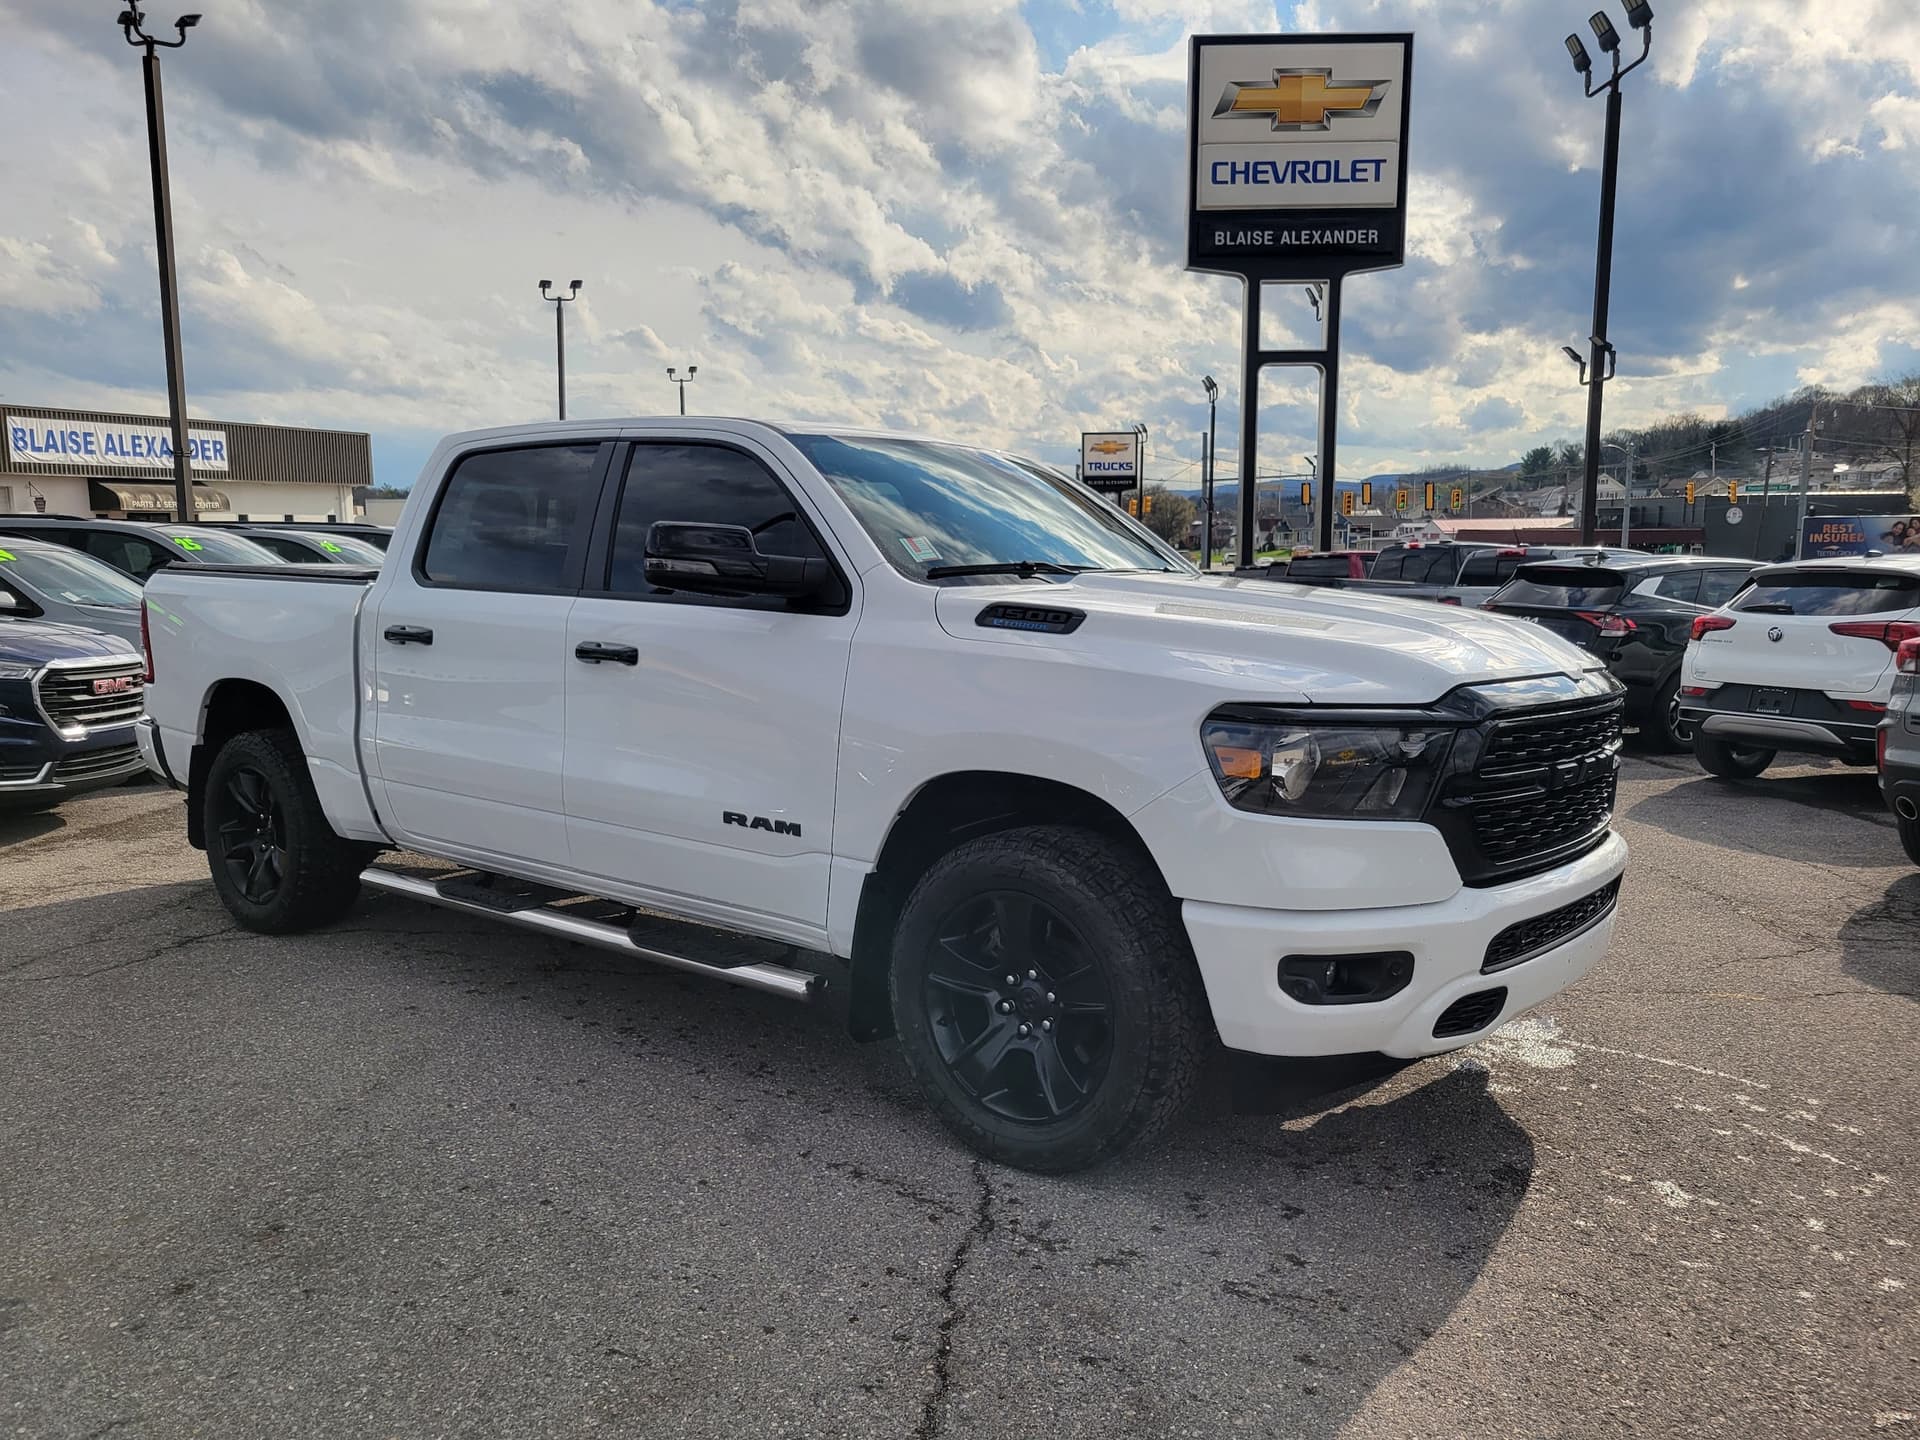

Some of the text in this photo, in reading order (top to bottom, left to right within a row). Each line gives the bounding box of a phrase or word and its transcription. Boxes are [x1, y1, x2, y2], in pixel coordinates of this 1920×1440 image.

[1211, 159, 1387, 185] CHEVROLET
[1214, 229, 1379, 246] BLAISE ALEXANDER
[12, 427, 226, 462] BLAISE ALEXADER
[1087, 462, 1133, 471] TRUCKS
[131, 500, 154, 508] PARTS
[1823, 523, 1855, 533] REST
[1809, 533, 1865, 543] INSURED
[991, 606, 1067, 624] 1500
[93, 676, 133, 695] GMC
[723, 810, 801, 837] RAM
